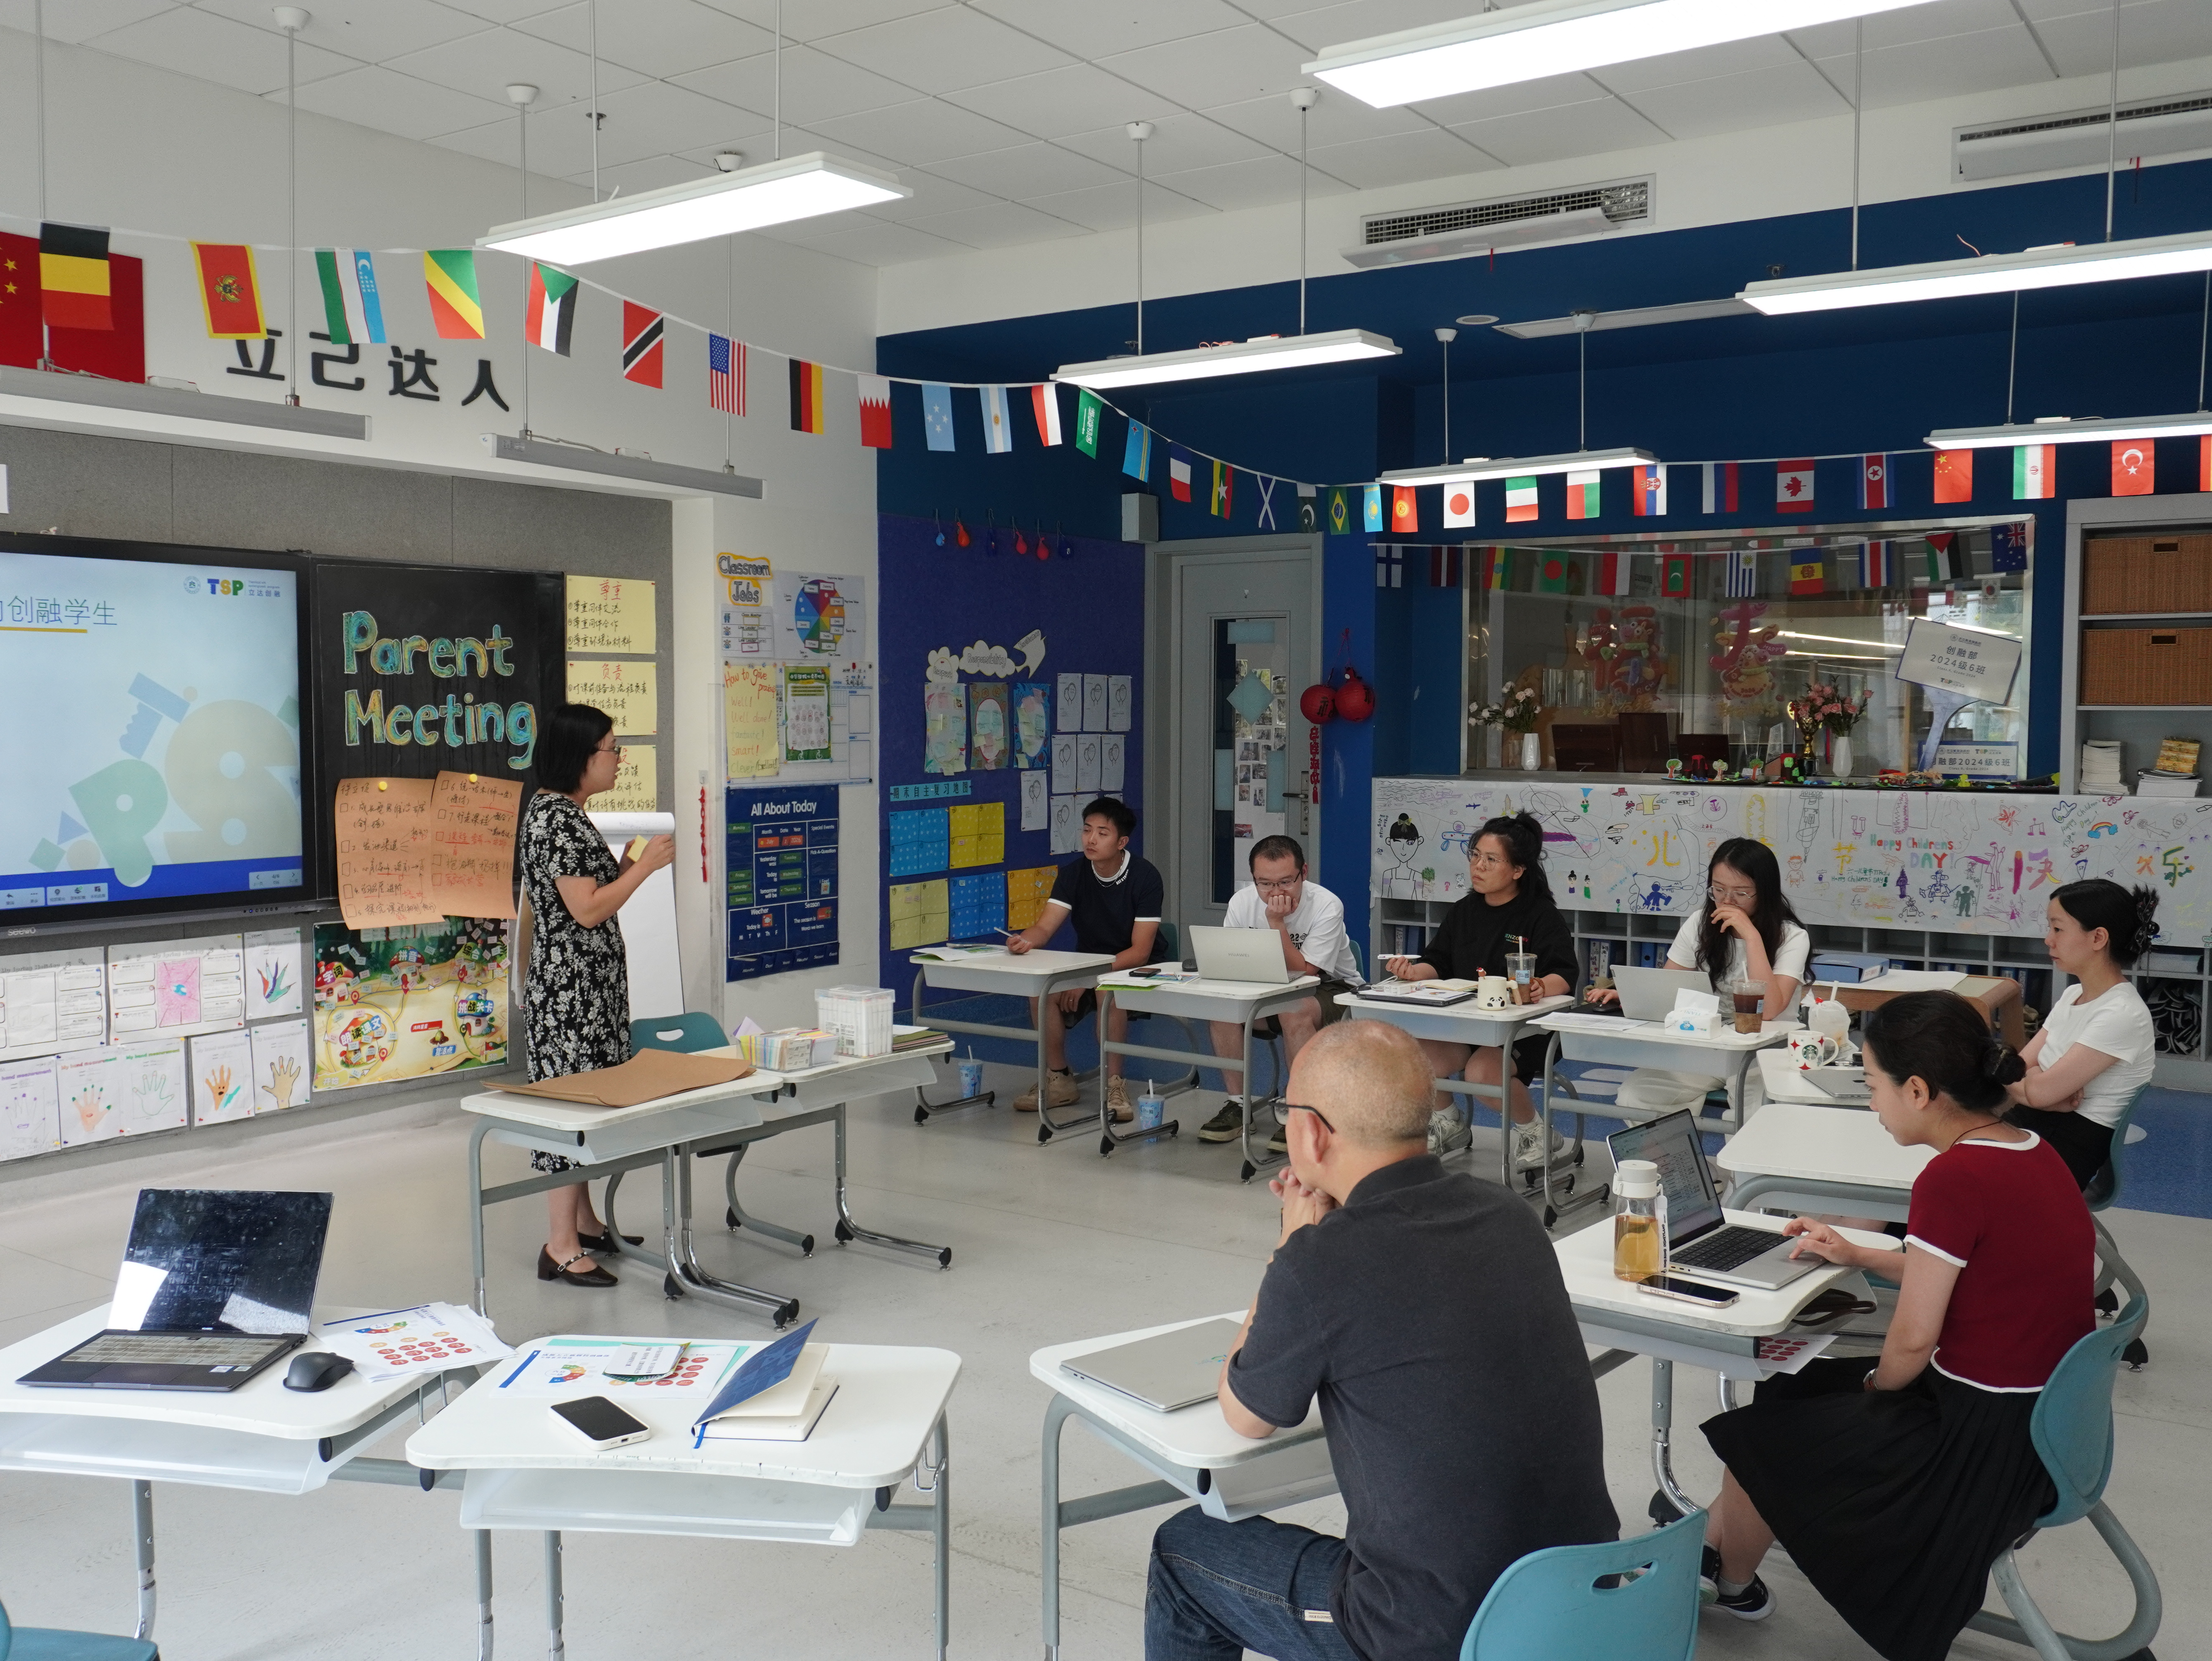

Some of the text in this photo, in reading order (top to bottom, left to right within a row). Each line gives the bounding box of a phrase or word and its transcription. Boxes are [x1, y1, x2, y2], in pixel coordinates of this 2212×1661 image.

[227, 329, 509, 412] 立己达人
[719, 556, 770, 576] Classroom
[207, 578, 244, 595] TSP
[599, 579, 622, 600] 尊重
[732, 581, 759, 603] Jobs
[343, 611, 514, 677] Parent
[1764, 644, 1784, 652] HAPPY
[1947, 646, 1978, 660] 创融部
[968, 653, 1006, 668] Responsibility
[1930, 654, 1986, 674] 2024级6班
[601, 663, 622, 681] 负责
[724, 668, 767, 688] How to give
[933, 666, 953, 679] Respect
[345, 689, 537, 769] Meeting
[732, 745, 759, 756] smart!
[893, 782, 969, 799] 期末自主复习地图
[751, 799, 817, 816] All About Today
[2061, 818, 2077, 835] Happy
[1870, 833, 1954, 851] Happy Childrens
[398, 949, 418, 962] 拼音
[323, 964, 343, 983] 字词
[458, 1001, 493, 1014] 挑战关卡
[340, 1016, 381, 1045] 朗读课文
